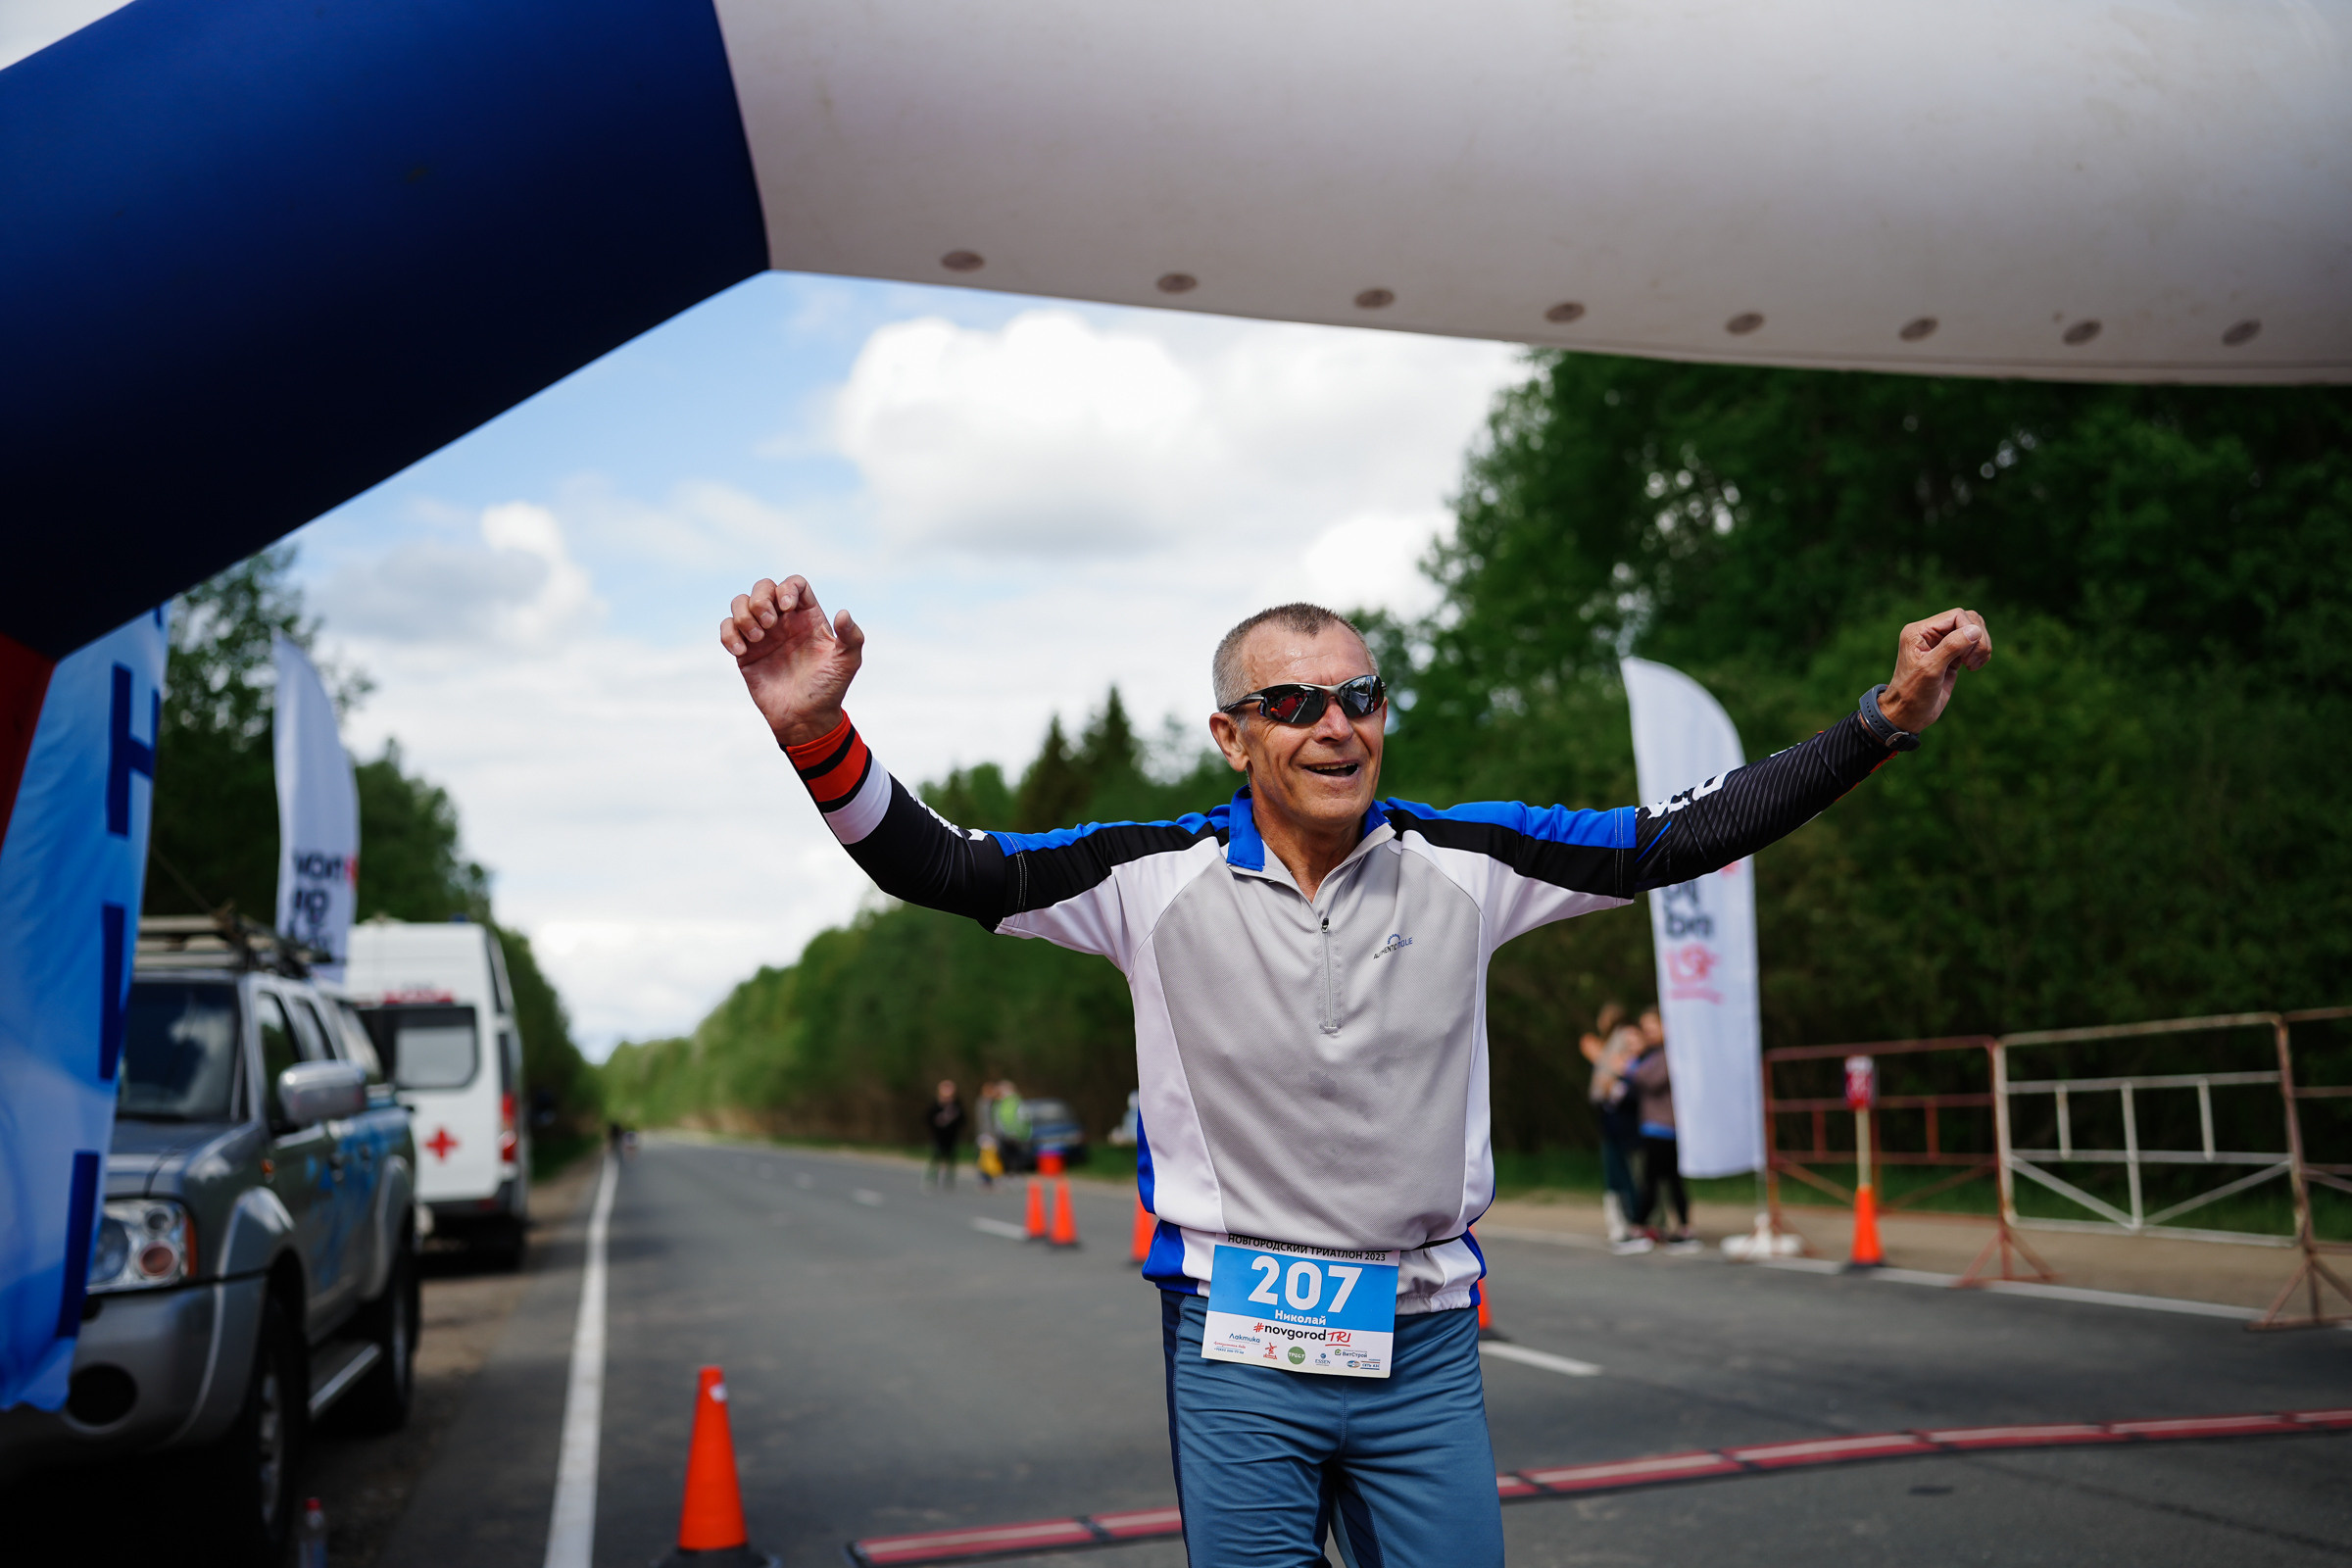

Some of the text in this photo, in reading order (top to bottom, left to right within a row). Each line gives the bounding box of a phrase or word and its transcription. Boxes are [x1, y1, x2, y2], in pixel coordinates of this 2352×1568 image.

[1311, 1248, 1363, 1260] ТРИАТЛОН
[1364, 1251, 1386, 1262] 2023
[1248, 1255, 1363, 1313] 207
[1274, 1309, 1326, 1326] Николай
